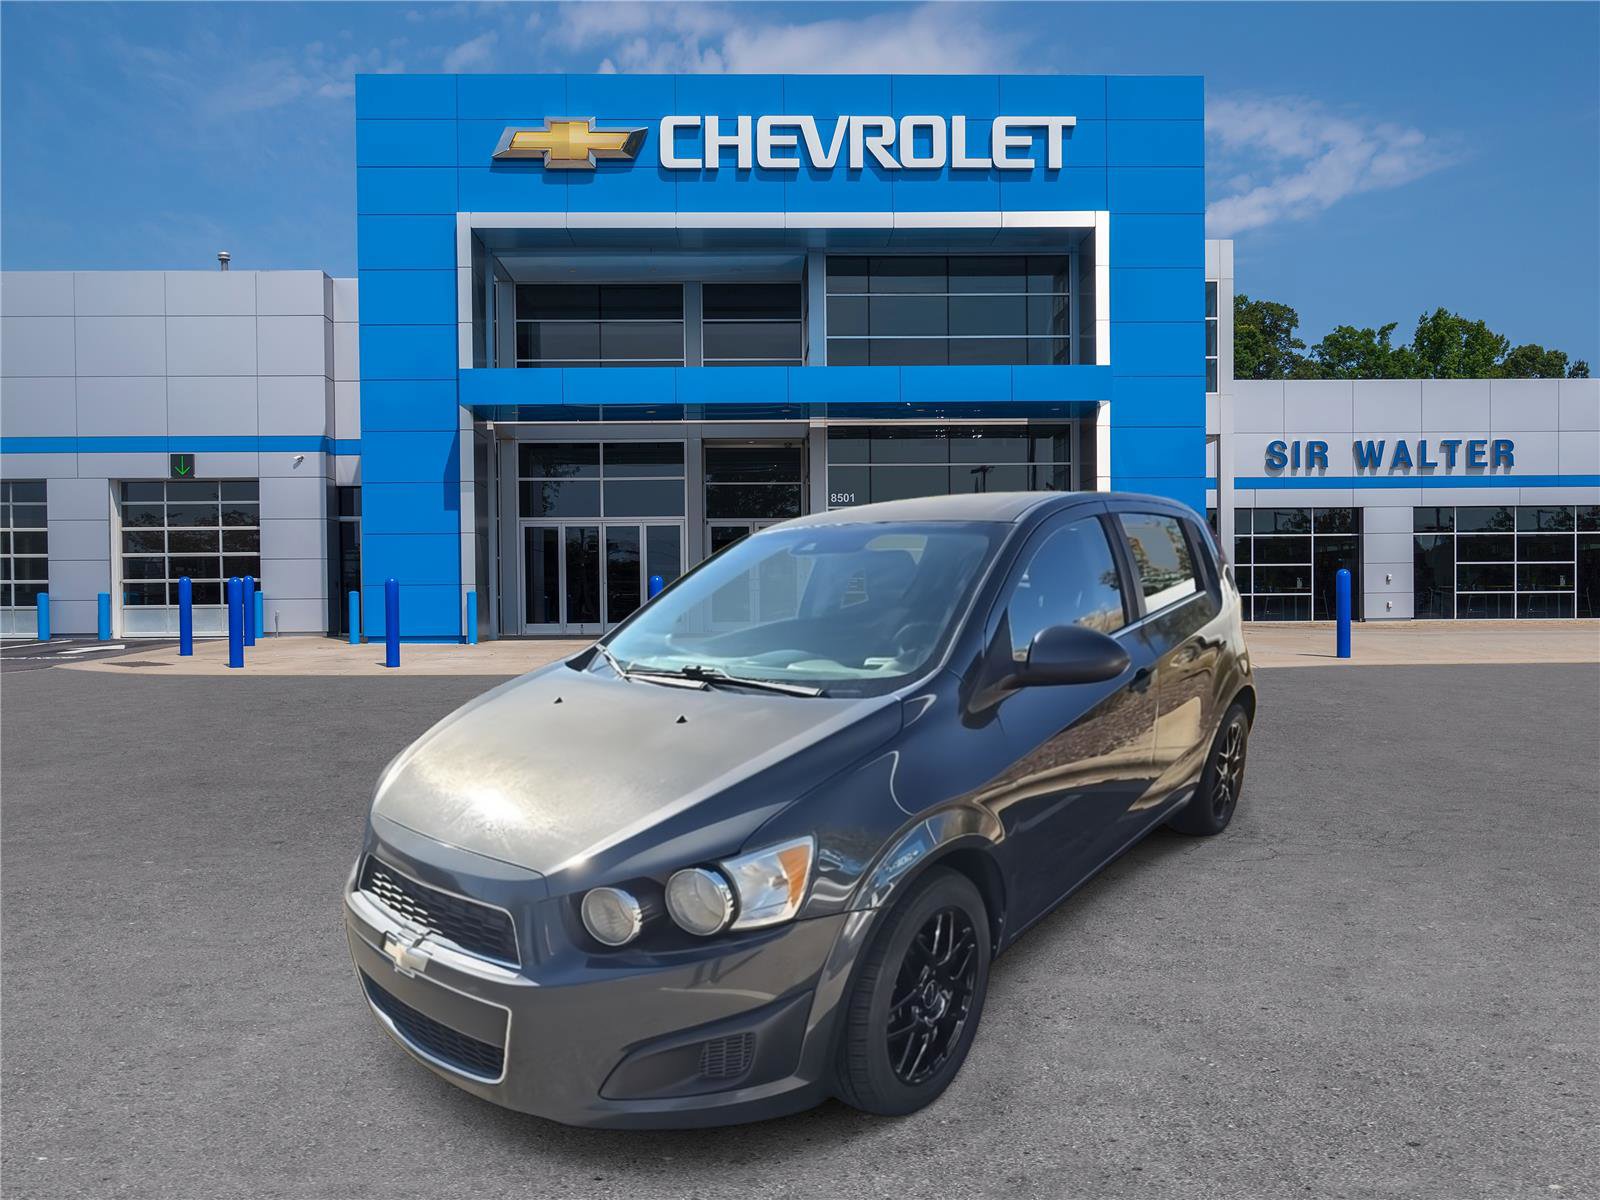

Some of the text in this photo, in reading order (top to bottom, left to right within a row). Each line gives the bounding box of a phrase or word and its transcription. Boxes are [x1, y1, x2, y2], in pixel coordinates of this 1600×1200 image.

[659, 115, 1077, 168] CHEVROLET
[1265, 439, 1515, 469] SIR WALTER
[830, 493, 856, 503] 8501
